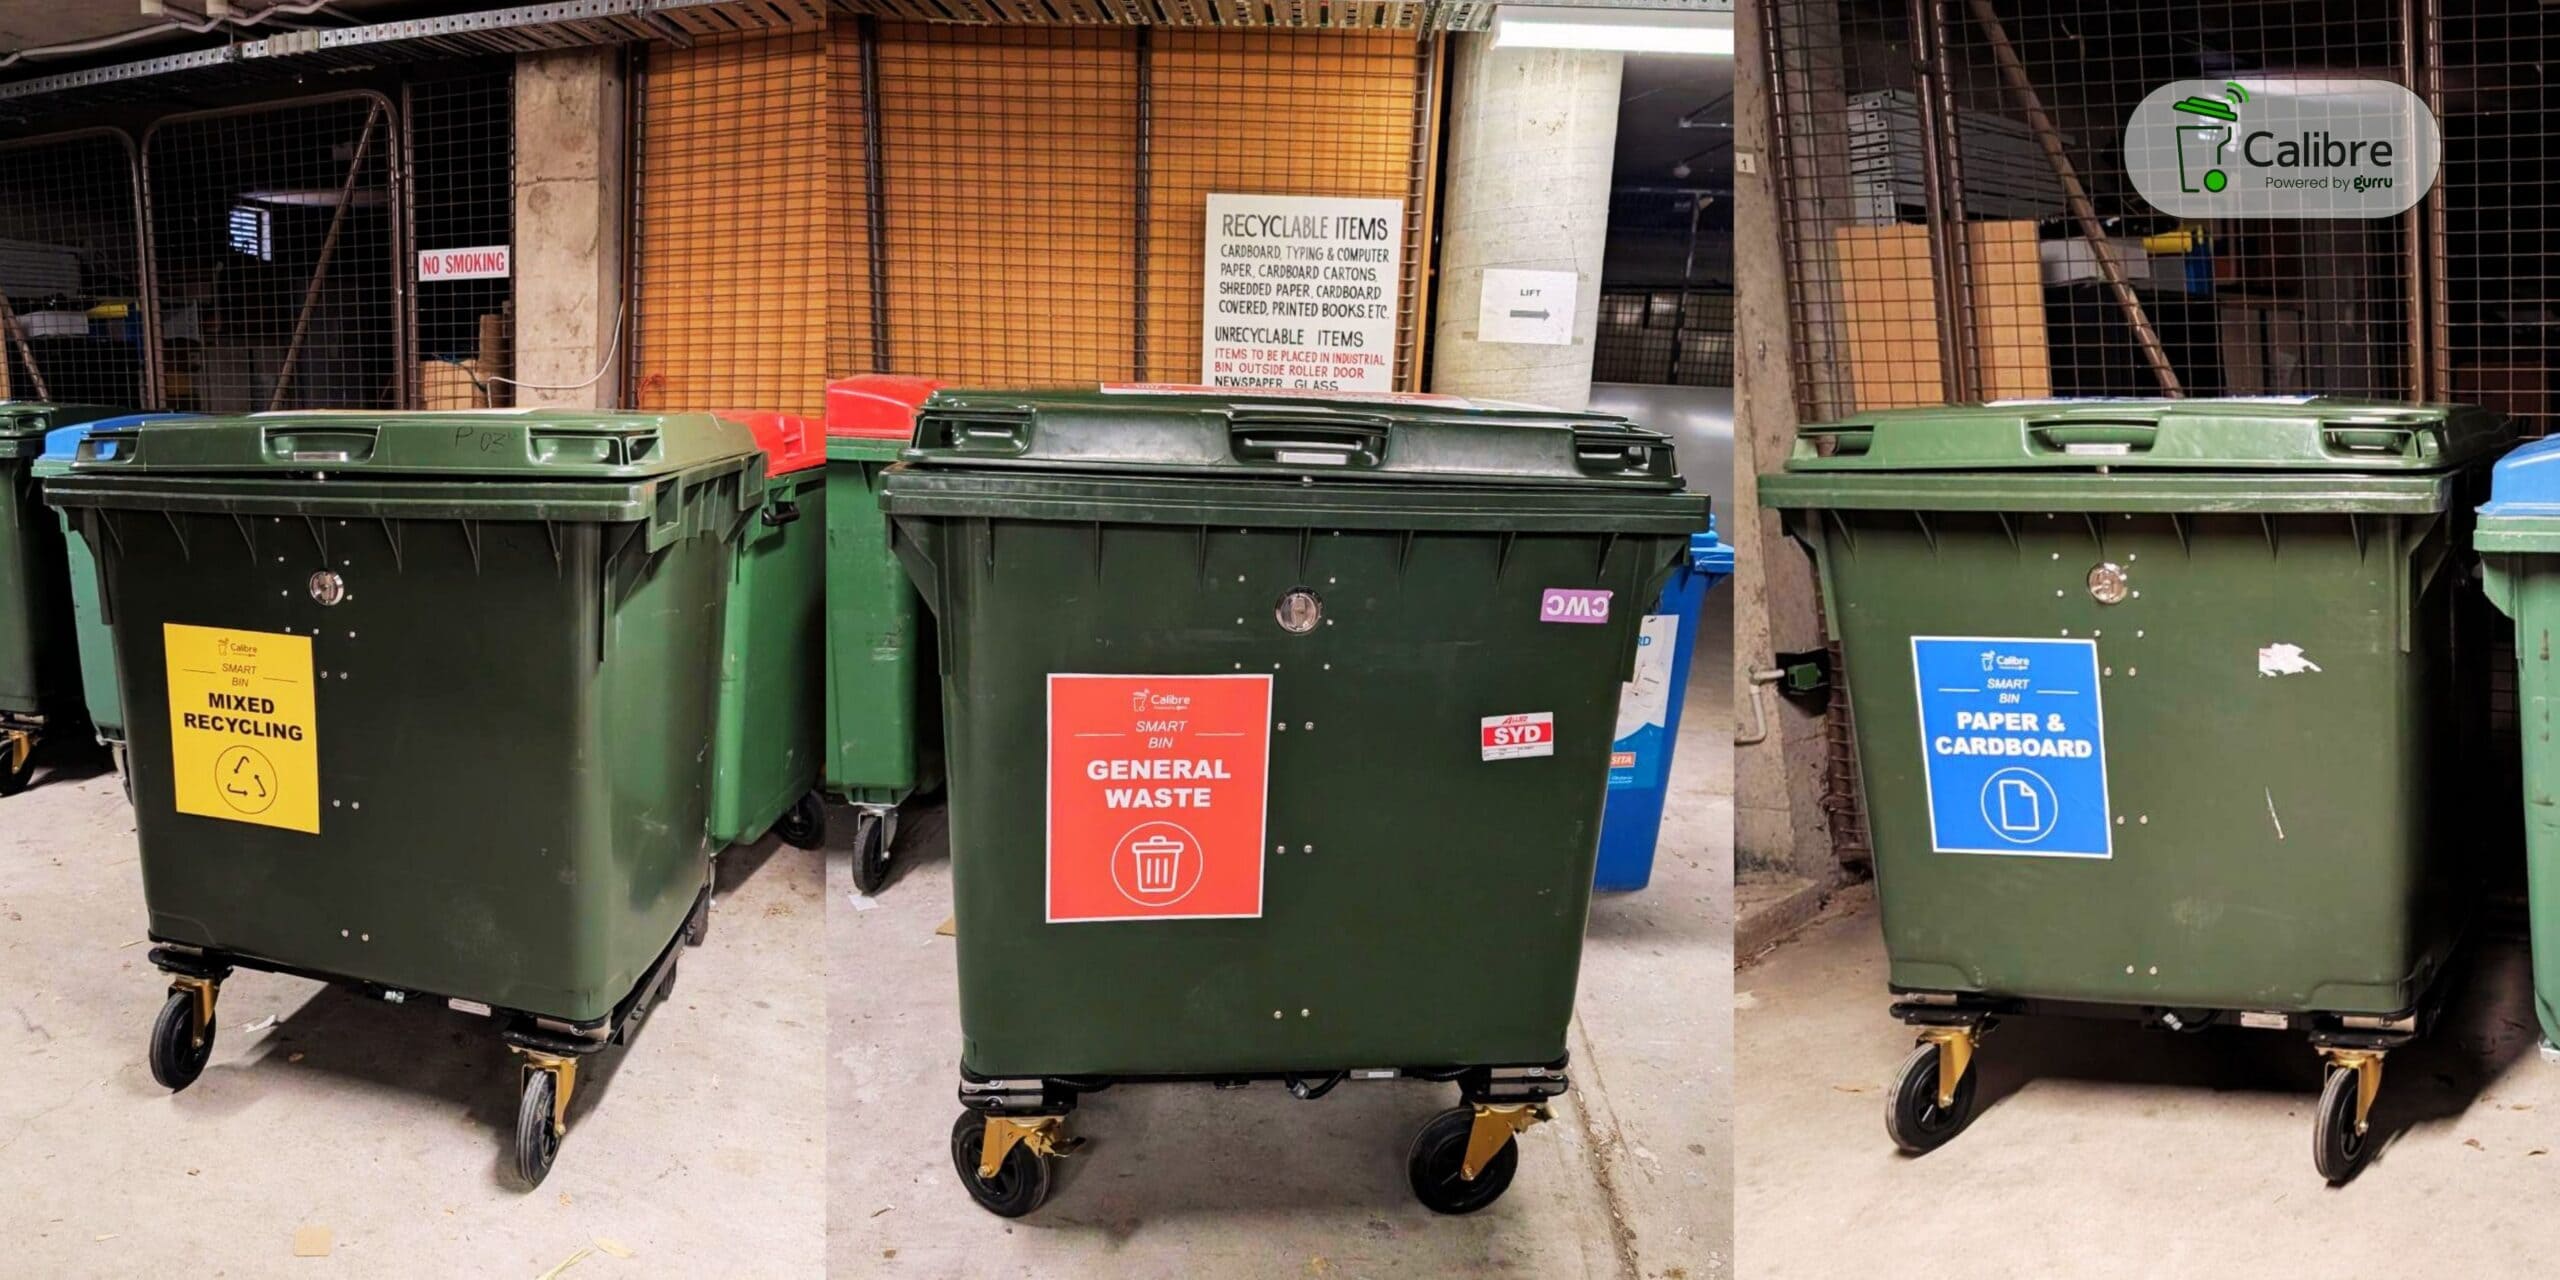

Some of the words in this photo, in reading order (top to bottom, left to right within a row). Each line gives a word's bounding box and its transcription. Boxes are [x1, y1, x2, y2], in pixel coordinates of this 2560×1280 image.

[1222, 213, 1329, 239] RECYCLABLE
[1335, 216, 1388, 241] ITEMS
[1287, 245, 1324, 261] TYPING
[1327, 247, 1335, 261] &
[1337, 247, 1390, 263] COMPUTER
[423, 255, 440, 275] NO
[445, 252, 505, 274] SMOKING
[1258, 264, 1319, 280] CARDBOARD
[1219, 281, 1272, 296] SHREDDED
[1316, 284, 1382, 300] CARDBOARD
[1520, 288, 1542, 297] LIFT
[1272, 301, 1318, 317] PRINTED
[1214, 326, 1305, 345] UNRECYCLABLE
[1317, 330, 1364, 348] ITEMS
[1214, 348, 1247, 360] ITEMS
[1251, 349, 1263, 361] TO
[1266, 350, 1279, 361] BE
[1280, 350, 1317, 363] PLACED
[1319, 352, 1330, 364] IN
[1332, 352, 1386, 366] INDUSTRIAL
[1214, 361, 1233, 373] BIN
[1238, 362, 1285, 376] OUTSIDE
[1288, 364, 1328, 378] ROLLER
[1333, 366, 1365, 379] DOOR
[1214, 375, 1283, 388] NEWSPAPER
[1294, 379, 1339, 392] GLASS
[230, 643, 257, 653] Calibre
[222, 663, 257, 675] SMART
[1996, 655, 2030, 666] Calibre
[231, 677, 249, 688] BIN
[1987, 678, 2030, 689] SMART
[208, 692, 275, 715] MIXED
[1150, 694, 1191, 705] Calibre
[1999, 693, 2020, 704] BIN
[183, 712, 303, 742] RECYCLING
[1135, 720, 1188, 733] SMART
[1957, 711, 2040, 732] PAPER
[2047, 713, 2066, 732] &
[1148, 737, 1173, 748] BIN
[1494, 726, 1541, 745] SYD
[1935, 736, 2093, 758] CARDBOARD
[1087, 759, 1231, 780] GENERAL
[1611, 756, 1633, 766] SITA
[1105, 788, 1211, 809] WASTE
